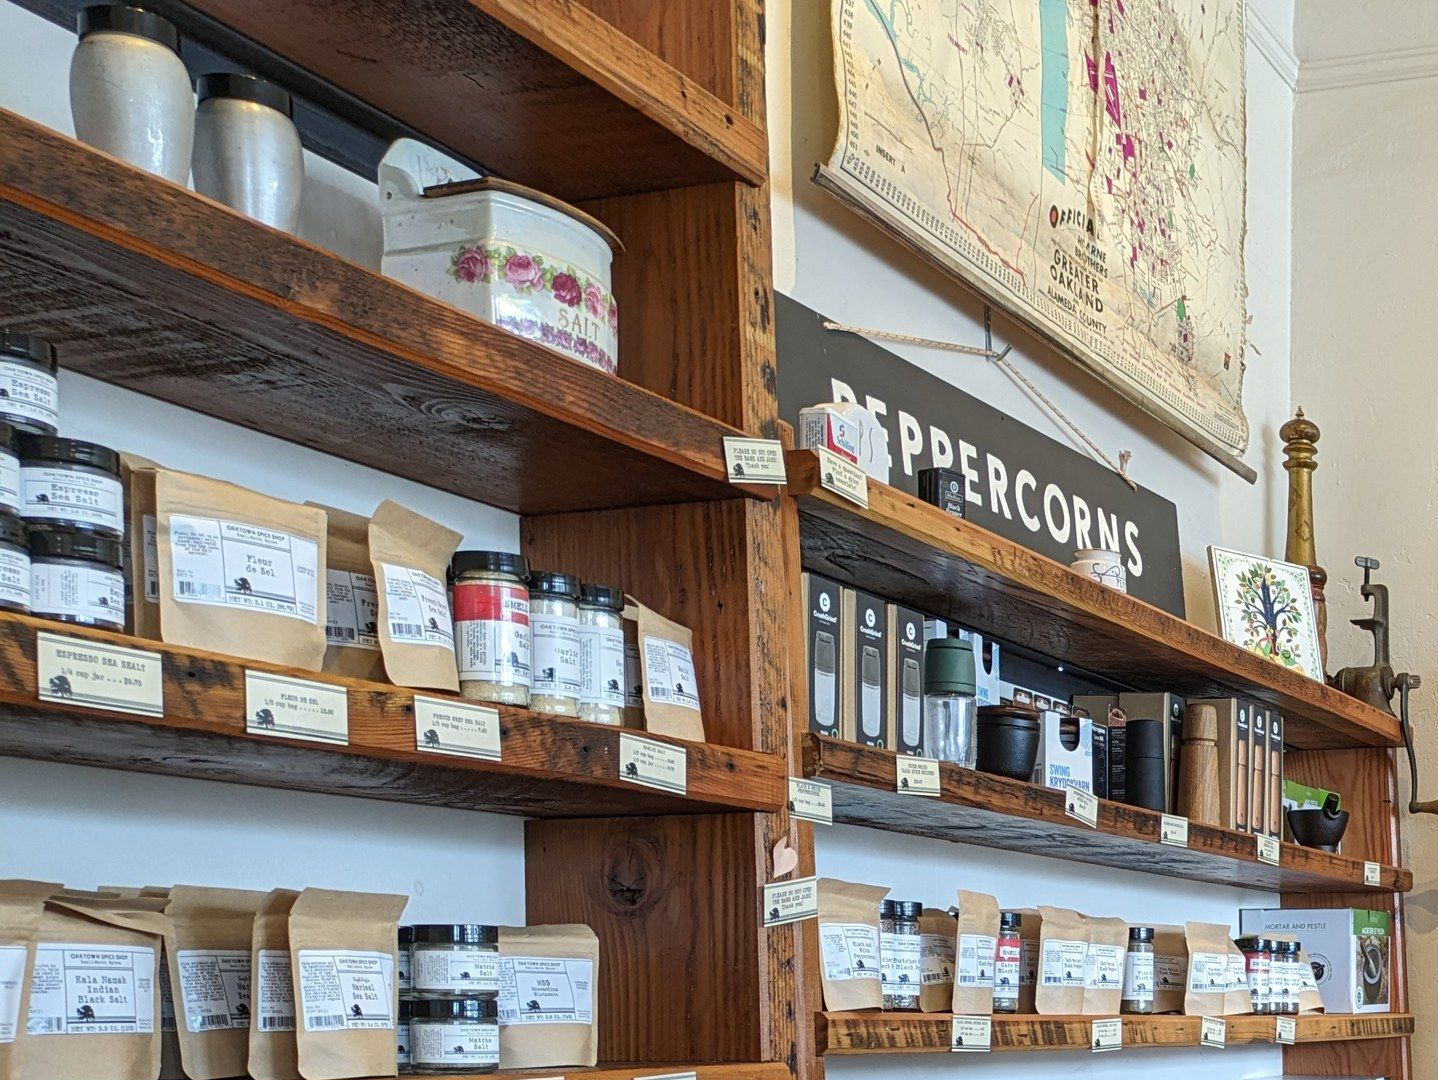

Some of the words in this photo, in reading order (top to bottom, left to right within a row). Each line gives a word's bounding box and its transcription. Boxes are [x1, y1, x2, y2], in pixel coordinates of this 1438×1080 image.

[1075, 249, 1109, 280] BROTHERS
[1053, 248, 1100, 296] GREATER
[1050, 264, 1105, 314] OAKLAND
[1047, 285, 1078, 314] ALAMEDA
[1079, 311, 1107, 333] COUNTY
[557, 309, 602, 340] SALT
[11, 379, 51, 398] Espresso
[11, 387, 30, 399] Sea
[34, 391, 51, 406] Salt
[733, 447, 750, 455] PLEASE
[51, 483, 99, 499] Espresso
[51, 492, 71, 502] Sea
[75, 495, 99, 506] Salt
[226, 525, 256, 535] OAKTOWN
[257, 531, 271, 539] SPICE
[246, 554, 272, 568] Fleur
[246, 564, 257, 574] de
[260, 567, 275, 578] Sel
[56, 650, 99, 665] ESPRESSO
[100, 658, 118, 669] SEA
[61, 668, 73, 676] 1/4
[75, 671, 90, 681] cup
[91, 673, 104, 682] jar
[1049, 763, 1071, 778] SWING
[1306, 922, 1326, 930] PESTLE
[75, 975, 97, 985] Kala
[100, 975, 127, 985] Namak
[536, 979, 551, 987] MSG
[87, 985, 119, 995] Indian
[352, 983, 375, 992] Marisal
[78, 995, 105, 1005] Black
[109, 995, 128, 1005] Salt
[469, 1036, 492, 1044] Matcha
